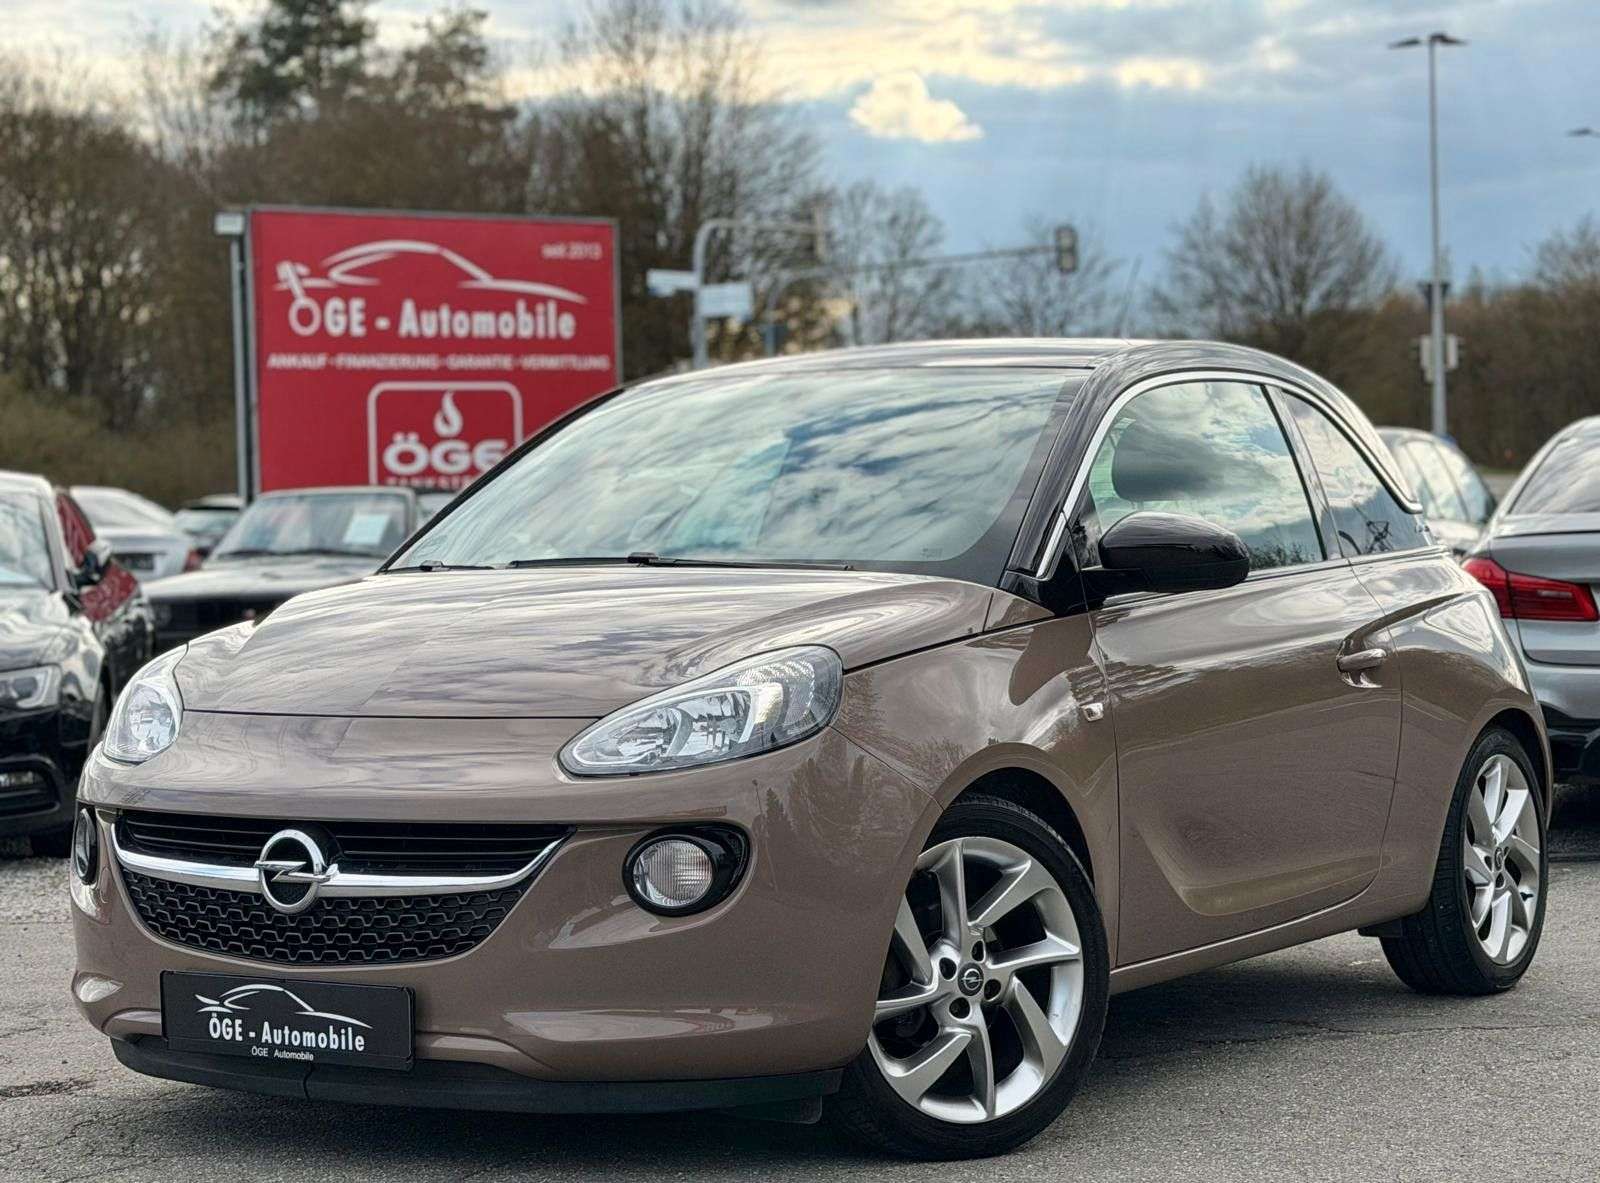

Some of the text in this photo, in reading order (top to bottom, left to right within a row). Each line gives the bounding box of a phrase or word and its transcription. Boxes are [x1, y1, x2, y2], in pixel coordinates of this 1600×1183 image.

[375, 316, 391, 330] -
[398, 298, 576, 340] Automobile
[383, 432, 508, 475] ÖGE
[209, 1012, 243, 1042] ÖGE
[261, 1021, 365, 1052] Automobile
[251, 1045, 314, 1061] ÖGE Automobile
